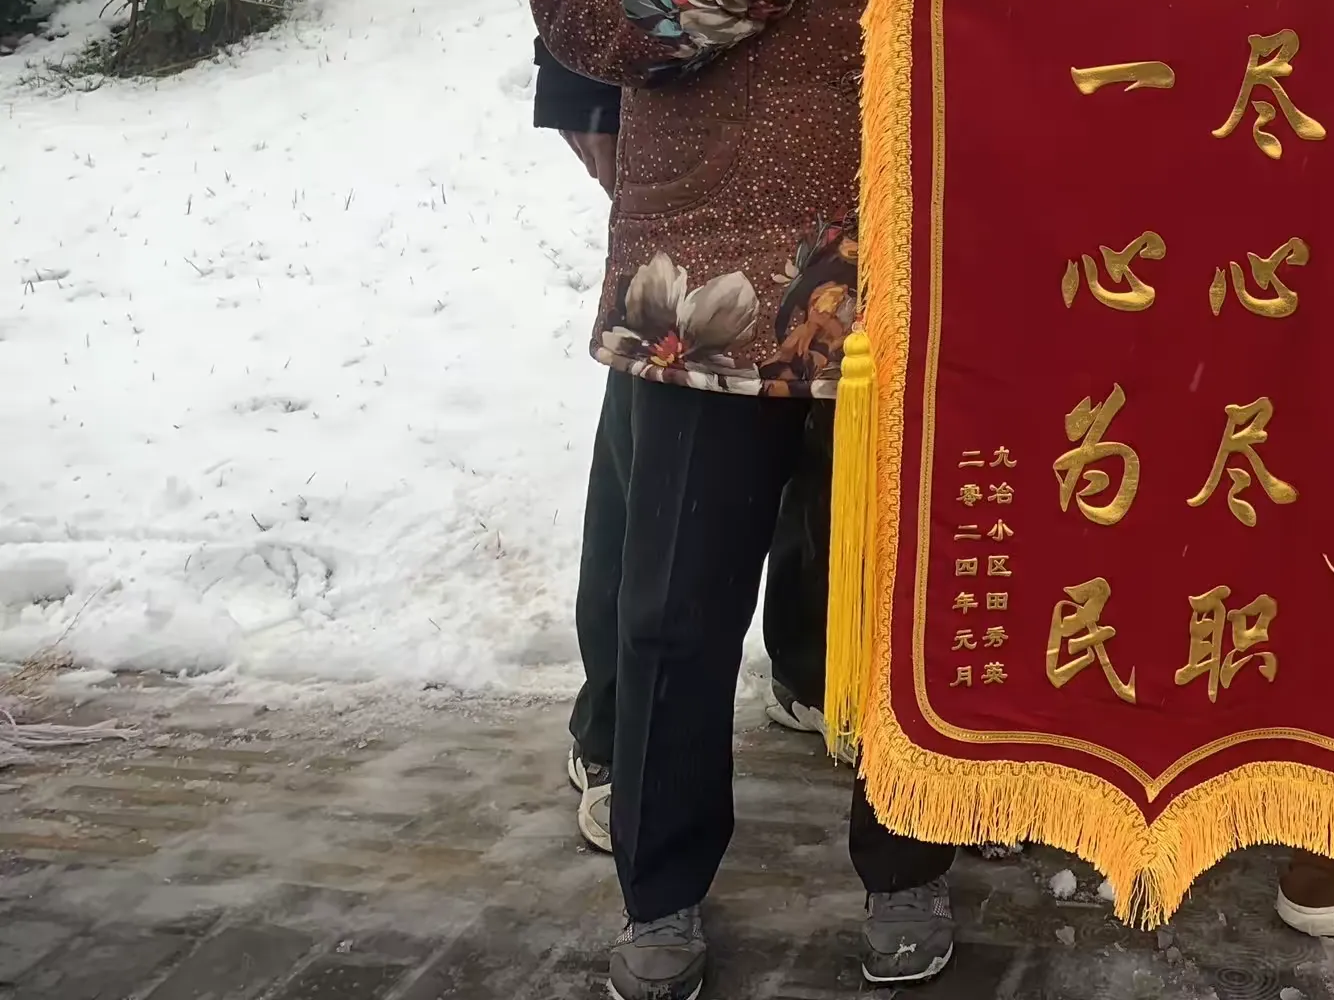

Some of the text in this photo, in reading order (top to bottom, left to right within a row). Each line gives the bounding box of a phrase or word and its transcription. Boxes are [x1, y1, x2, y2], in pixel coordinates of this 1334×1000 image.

[949, 450, 985, 688] 二零二四年元月
[980, 445, 1018, 685] 九冶小区田秀英
[1046, 60, 1176, 703] 一心为民
[1175, 28, 1327, 703] 尽心尽职
